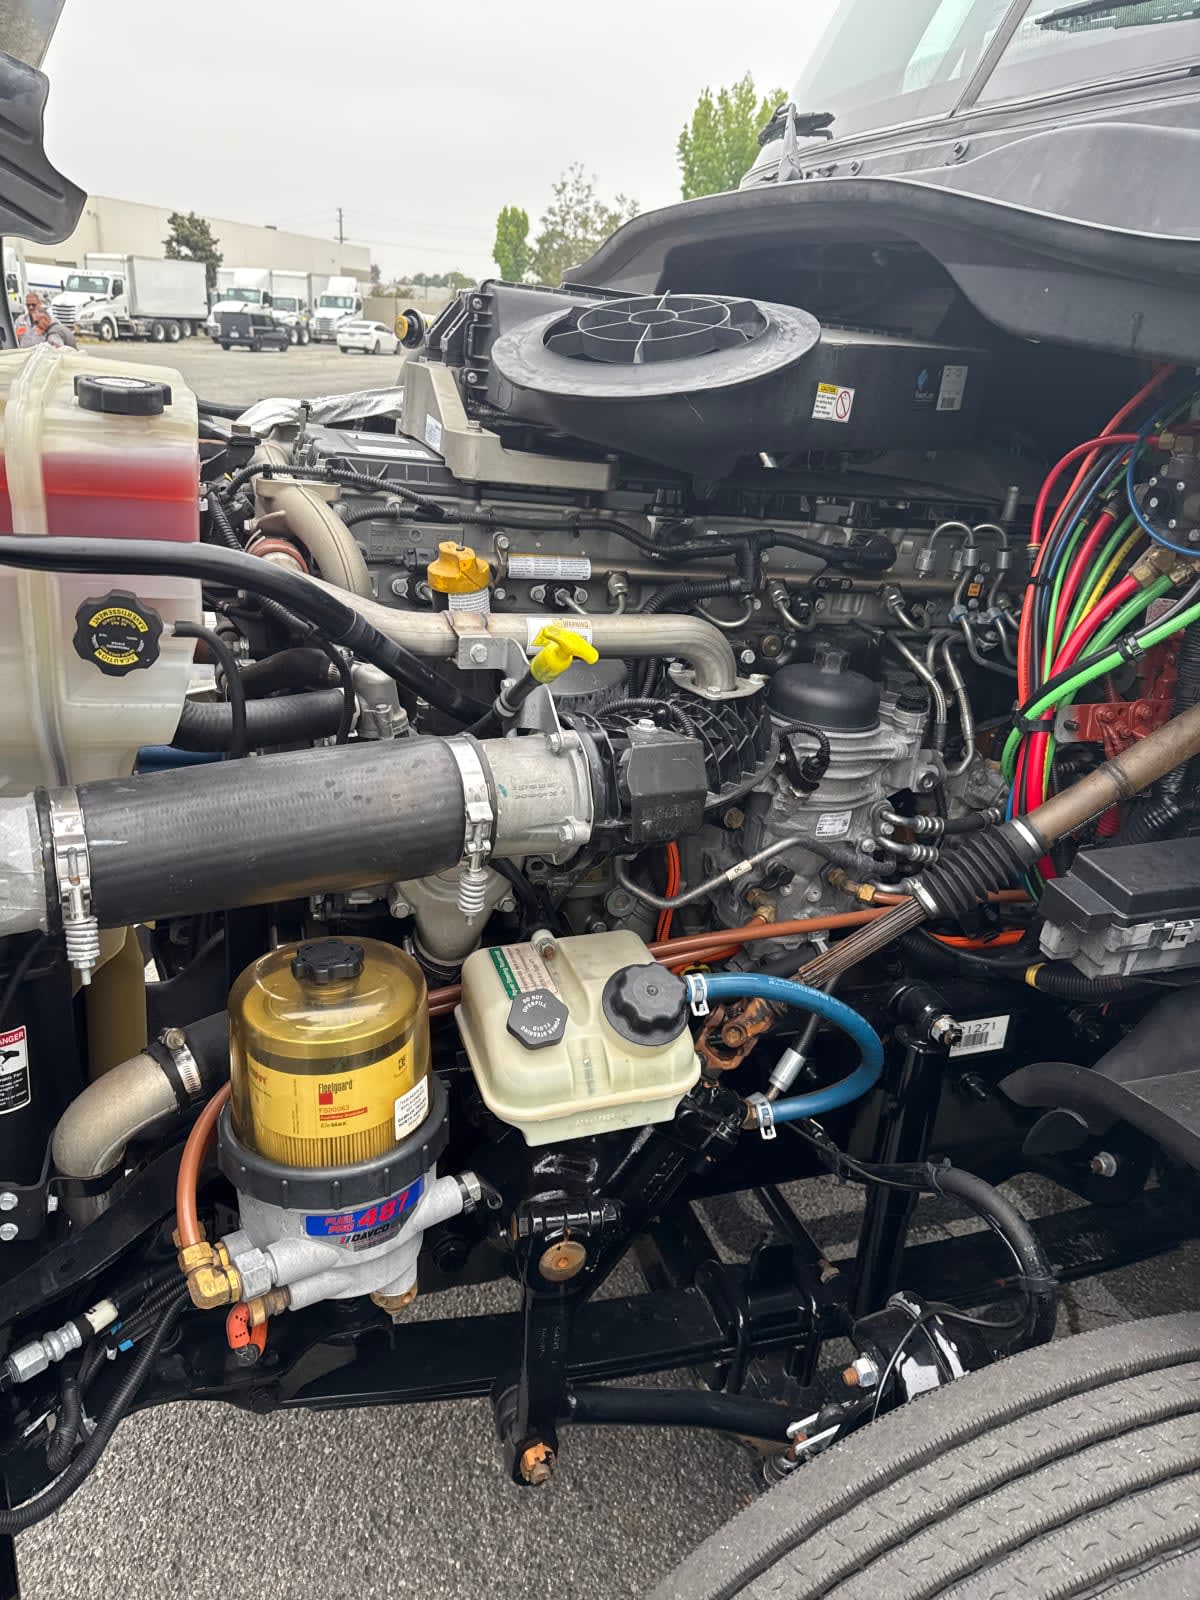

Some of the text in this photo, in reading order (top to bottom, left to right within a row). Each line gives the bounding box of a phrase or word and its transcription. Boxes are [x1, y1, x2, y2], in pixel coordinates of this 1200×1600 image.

[91, 608, 143, 628] AVERTISSEMENT
[97, 650, 131, 665] CAUTION
[521, 1000, 547, 1013] OVERFILL
[522, 996, 531, 1004] DO
[520, 1024, 548, 1038] STEERING
[532, 1022, 551, 1031] FLUID
[318, 1079, 353, 1095] Fleetguard
[358, 1190, 410, 1227] 487
[324, 1215, 354, 1225] FUEL
[327, 1223, 355, 1234] PRO
[351, 1223, 390, 1243] DAVCO
